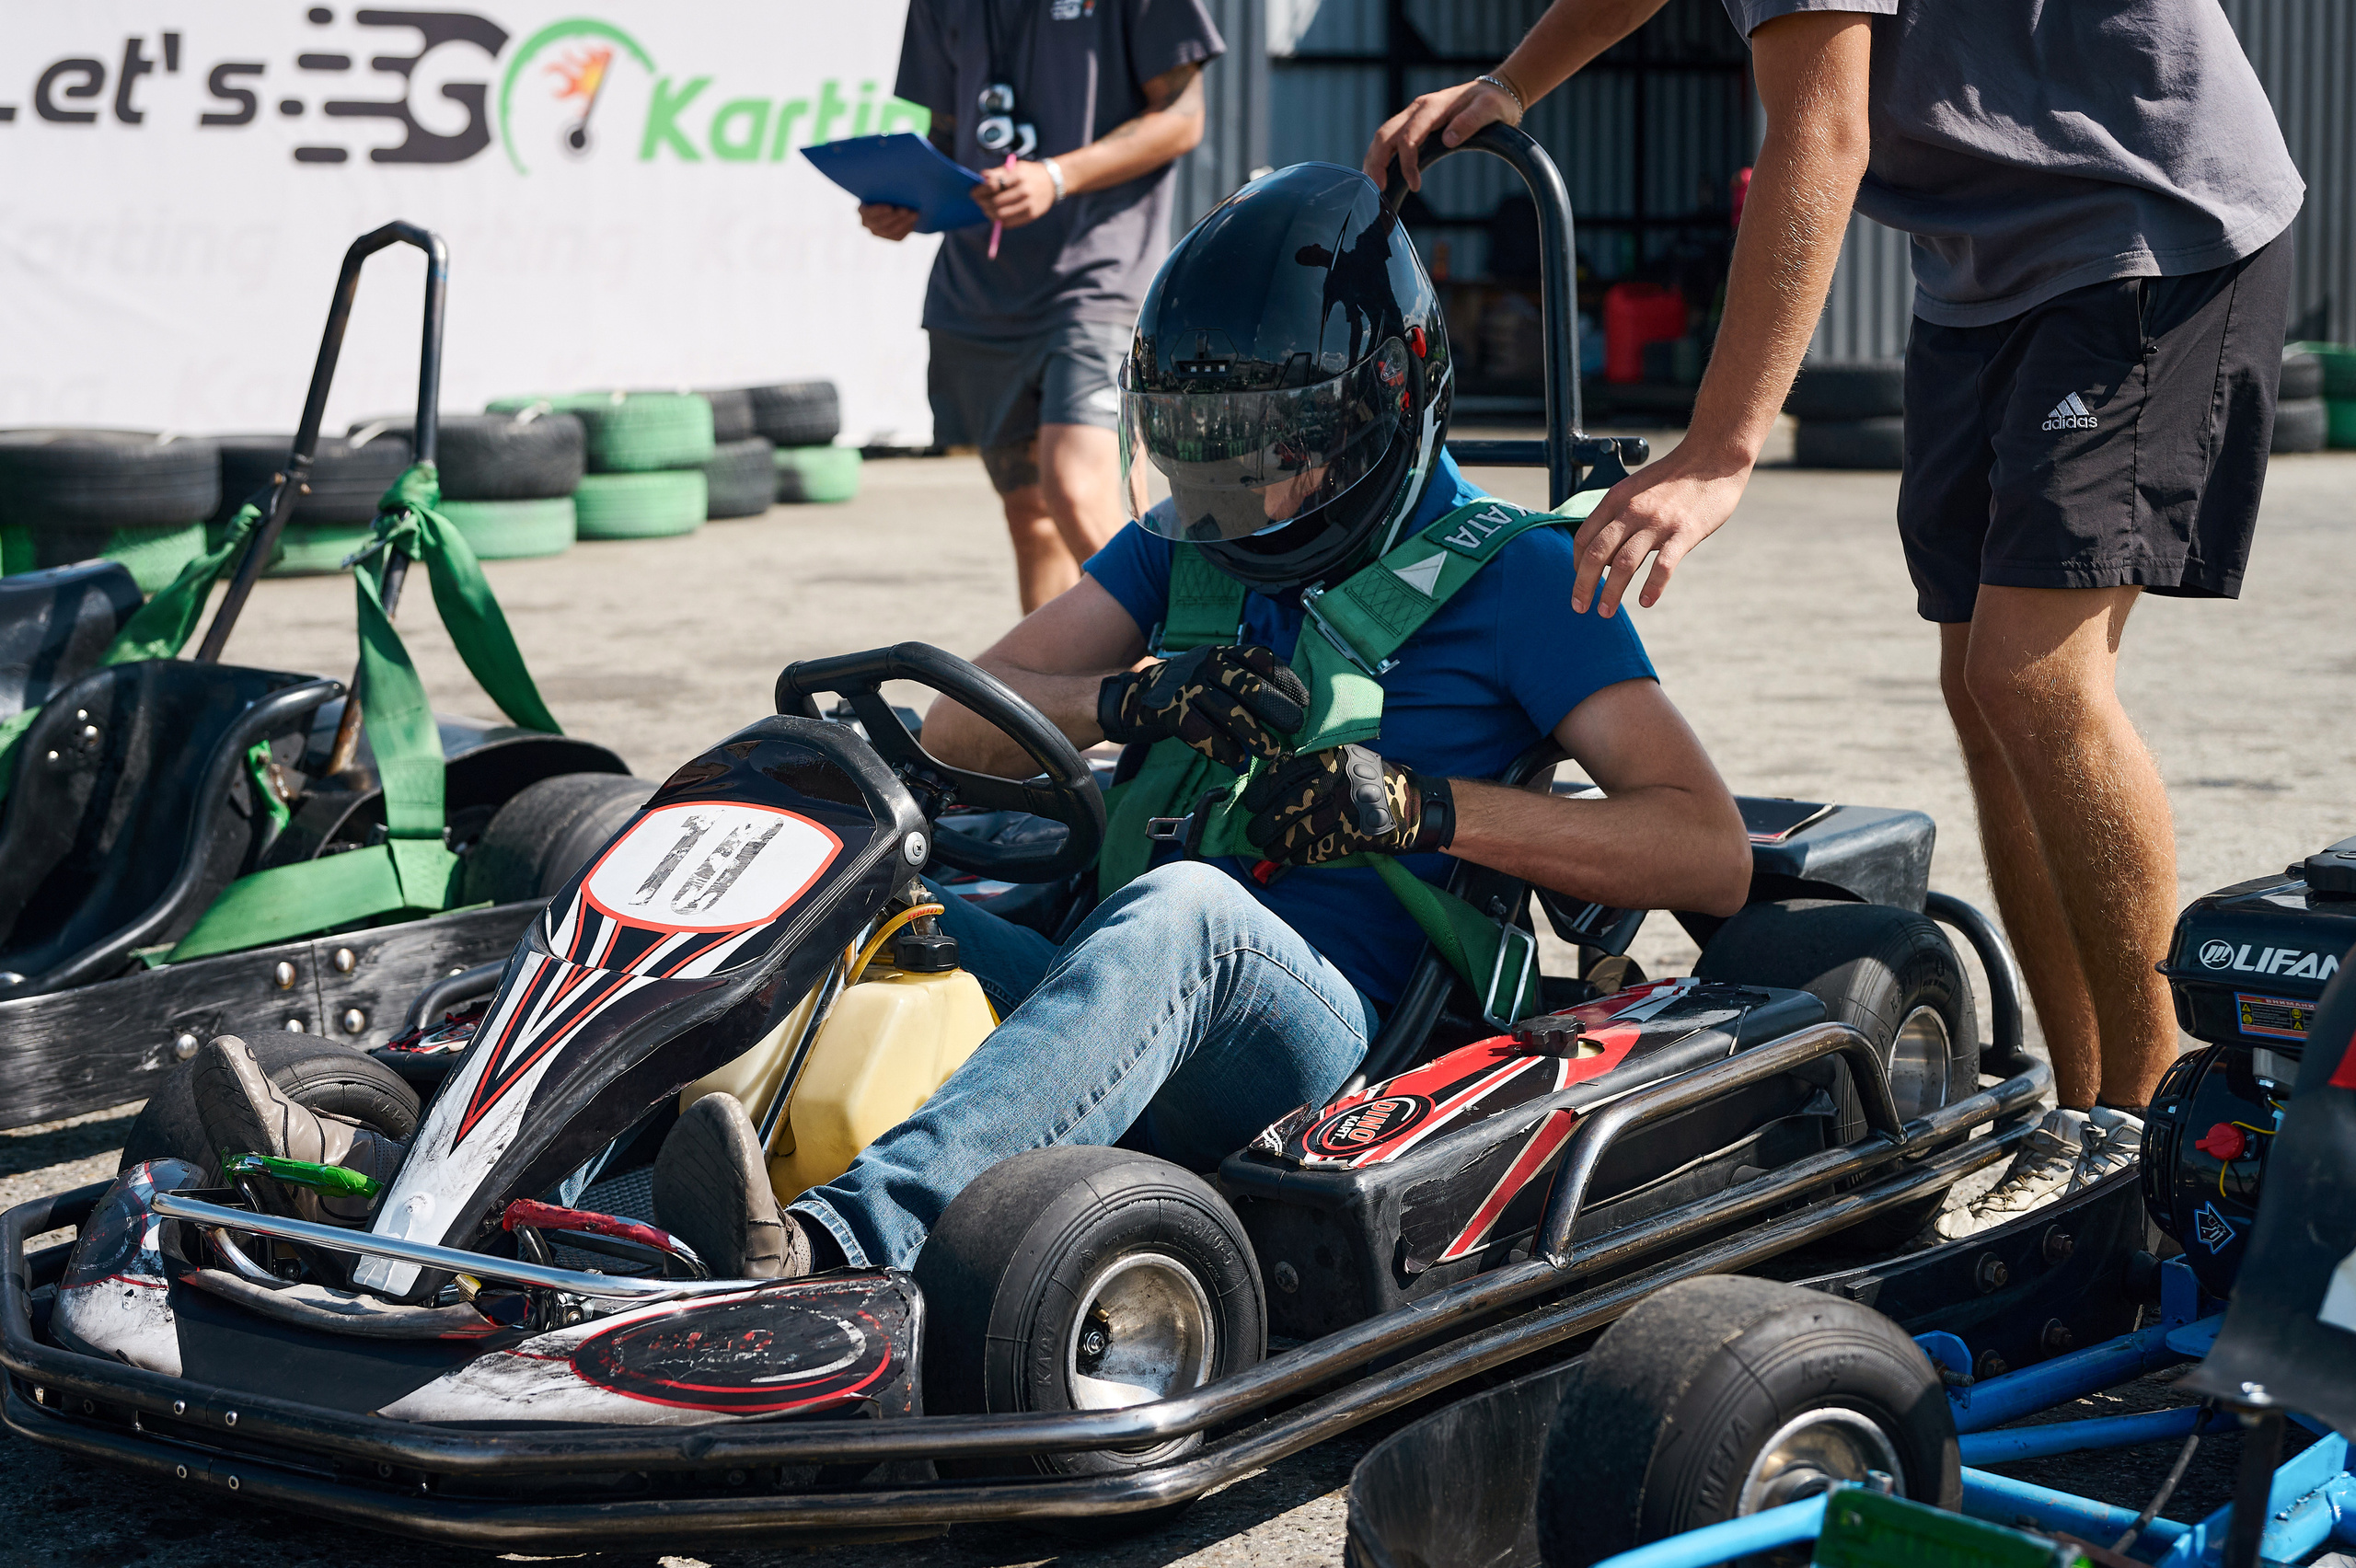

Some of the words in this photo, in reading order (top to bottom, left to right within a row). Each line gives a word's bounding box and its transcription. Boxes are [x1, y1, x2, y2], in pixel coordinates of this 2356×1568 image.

[0, 33, 265, 127] et's
[638, 74, 932, 162] Kartin
[2041, 414, 2098, 431] adidas
[2264, 998, 2316, 1009] ВНИМАНИ
[1334, 1114, 1361, 1139] KART
[1348, 1101, 1400, 1142] DINO
